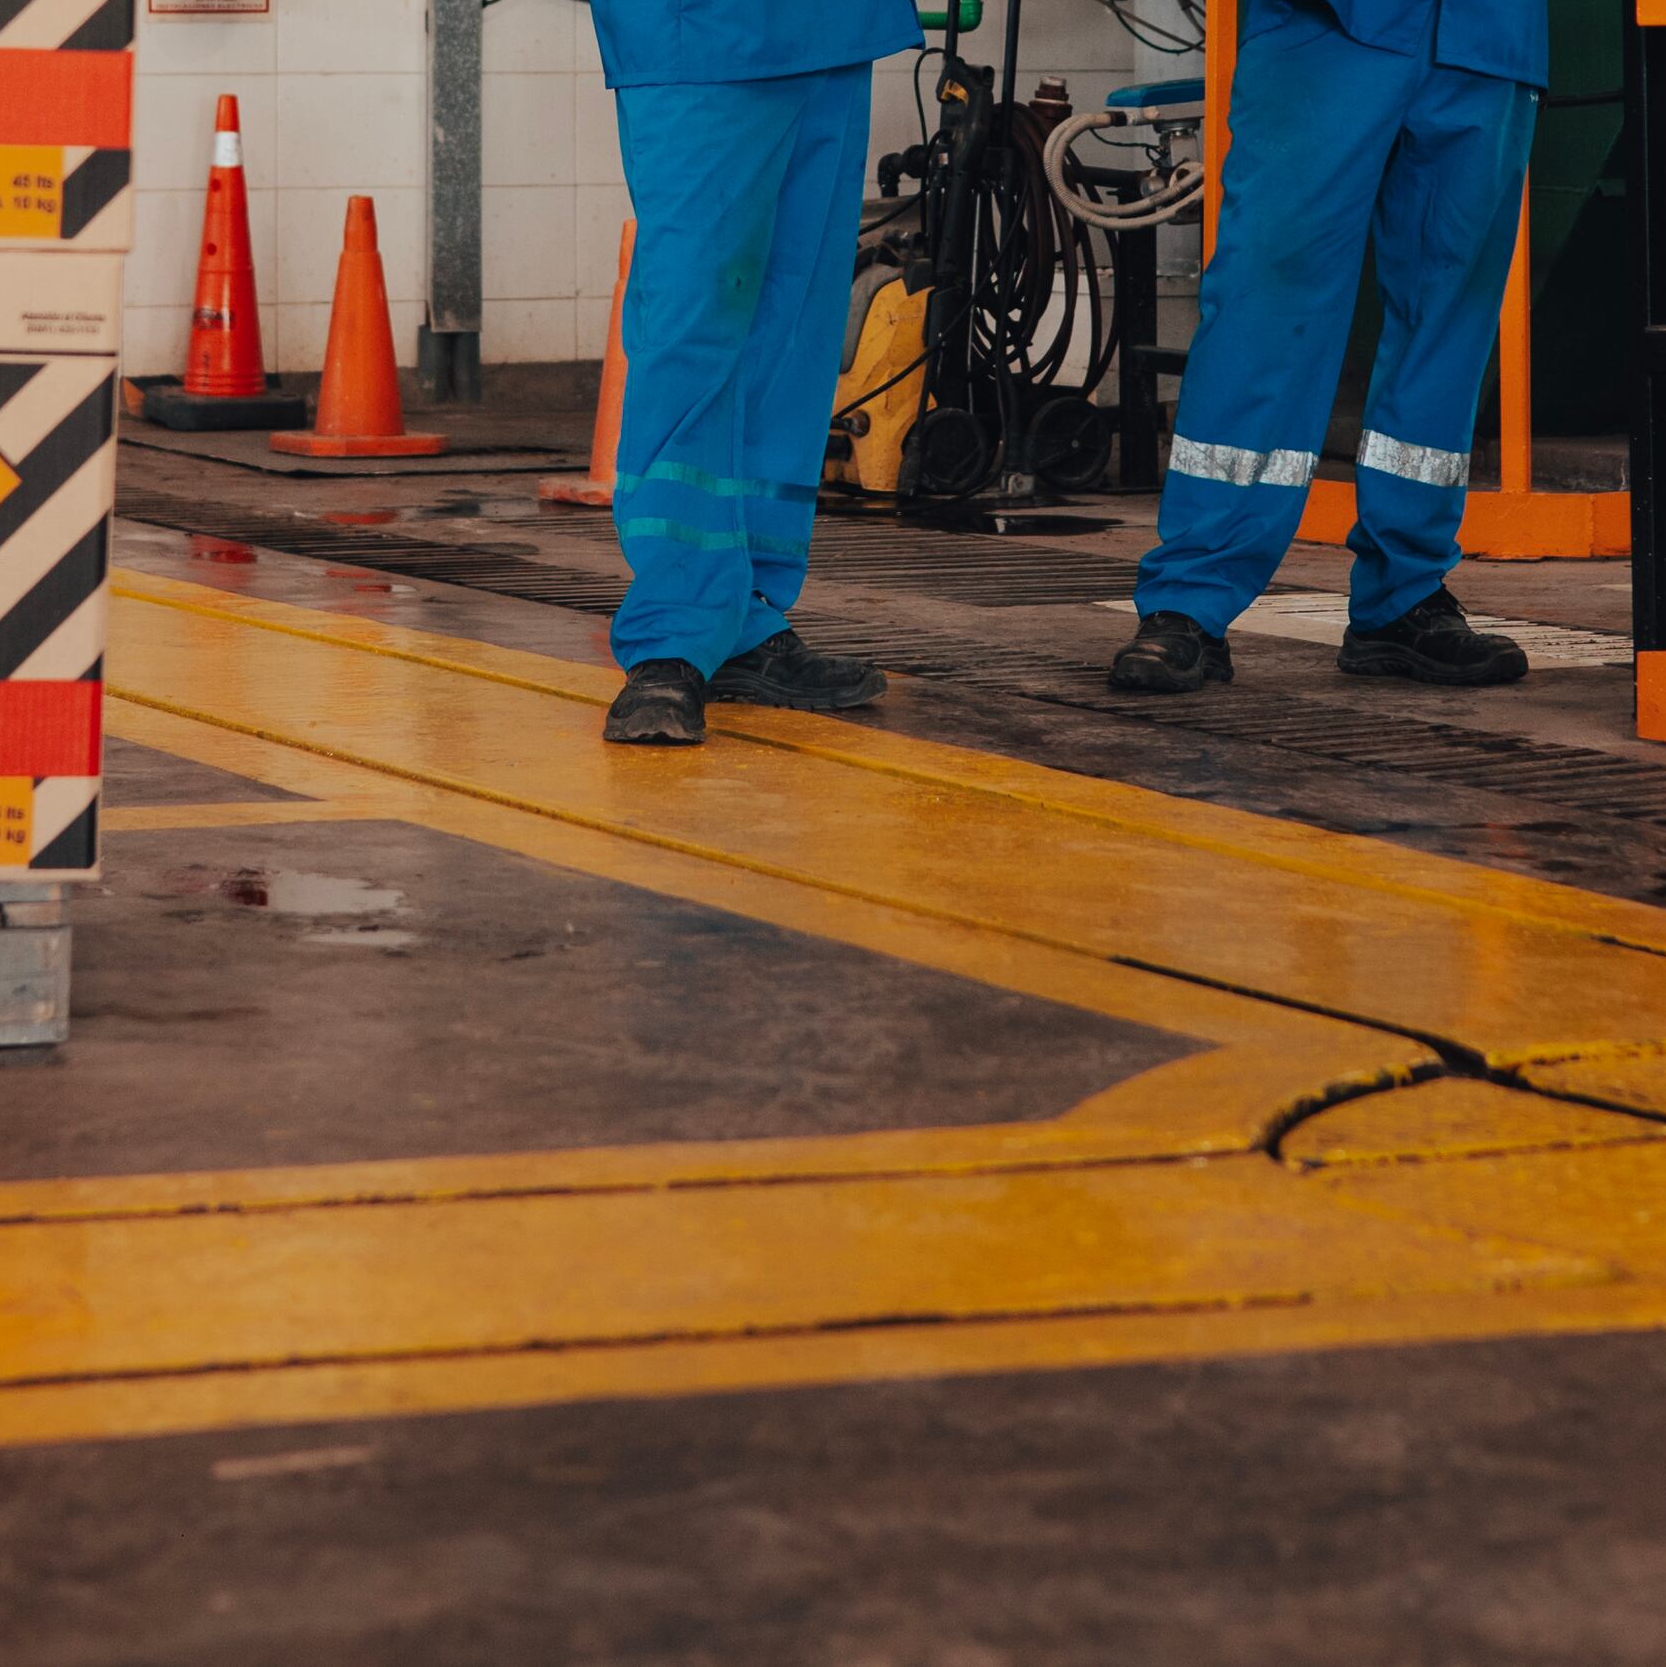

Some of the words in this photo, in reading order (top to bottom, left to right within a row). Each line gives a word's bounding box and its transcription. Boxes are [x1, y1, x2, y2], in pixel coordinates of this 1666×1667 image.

[10, 173, 31, 188] 45
[34, 174, 54, 189] lts
[12, 195, 31, 210] 10
[36, 196, 57, 213] kg
[5, 805, 24, 820] lts
[5, 827, 26, 843] kg
